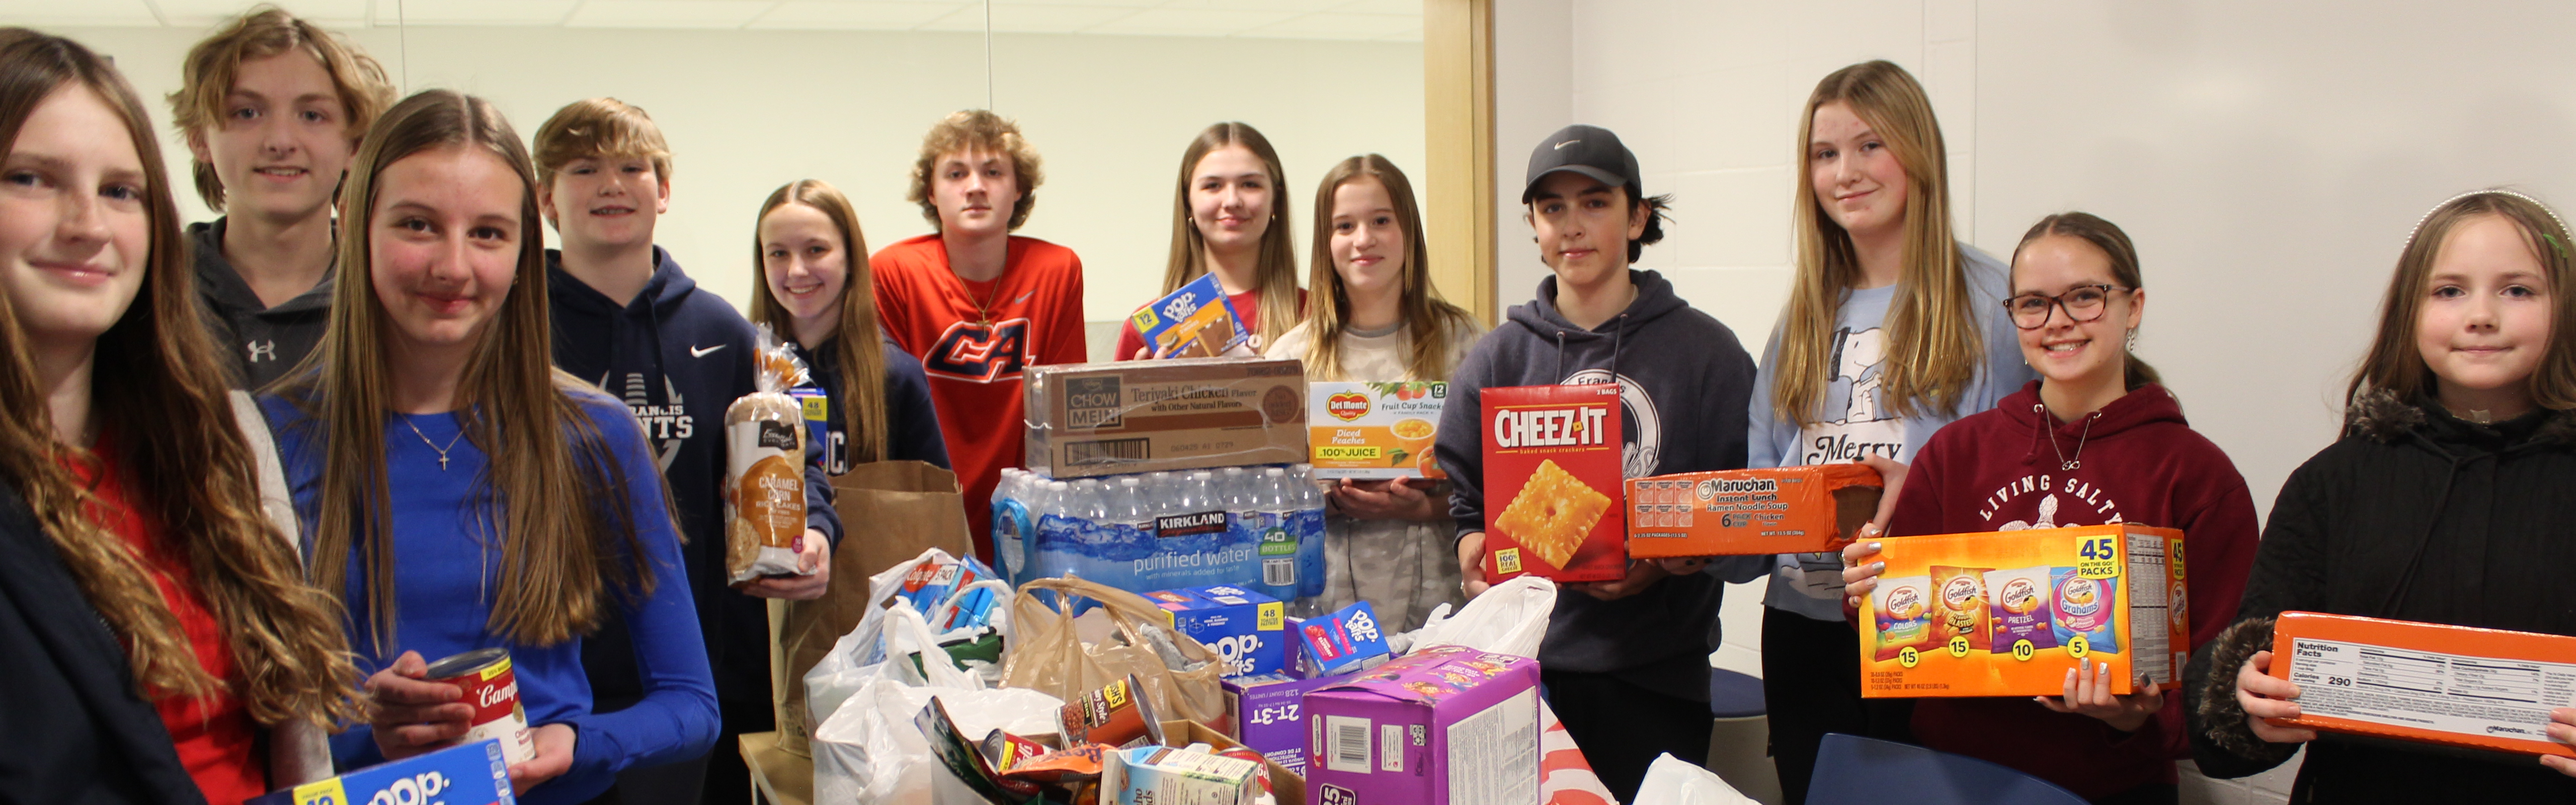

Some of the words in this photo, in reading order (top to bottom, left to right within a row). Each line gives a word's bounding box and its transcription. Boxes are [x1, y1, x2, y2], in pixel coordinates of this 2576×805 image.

[1138, 313, 1152, 325] 12
[923, 318, 1037, 384] CA
[1071, 392, 1117, 407] CHOW
[1131, 386, 1178, 403] Teriyaki
[1181, 384, 1229, 400] Chicken
[627, 404, 684, 416] RANCIS
[1151, 403, 1167, 411] with
[1168, 402, 1188, 411] Other
[1190, 401, 1216, 410] Natural
[1217, 400, 1242, 408] Flavors
[1330, 401, 1343, 409] Del
[1343, 401, 1367, 409] Monte
[1381, 403, 1399, 411] Fruit
[1401, 402, 1417, 411] Cup
[1419, 402, 1442, 410] Snack
[1072, 409, 1115, 424] MEIN
[1336, 429, 1361, 437] Diced
[1345, 448, 1376, 457] JUICE
[1806, 434, 1903, 465] Merry
[759, 477, 800, 491] CARAMEL
[1716, 494, 1749, 503] Instant
[1751, 493, 1777, 502] Lunch
[1979, 474, 2051, 521] LIVING
[2064, 478, 2123, 526] SALTY
[1706, 503, 1735, 512] Ramen
[1736, 502, 1766, 511] Noodle
[1767, 502, 1789, 512] Soup
[1160, 513, 1225, 529] KIRKLAND
[1721, 513, 1732, 528] 6
[1264, 531, 1285, 542] 40
[2080, 538, 2114, 560] 45
[2173, 543, 2183, 562] 45
[1133, 550, 1200, 576] purified
[1207, 548, 1251, 565] water
[1161, 569, 1191, 578] minerals
[2081, 566, 2113, 575] PACKS
[1947, 585, 1977, 600] Goldfish
[2068, 583, 2093, 595] Goldfish
[1890, 592, 1920, 610] Goldfish
[2005, 587, 2035, 604] Goldfish
[2062, 600, 2098, 615] Grahams
[1893, 620, 1918, 630] COLORS
[1948, 618, 1974, 628] BLASTED
[2008, 615, 2034, 624] PRETZEL
[1950, 641, 1966, 653] 15
[2015, 644, 2031, 656] 10
[2074, 642, 2082, 653] 5
[2296, 648, 2322, 657] Facts
[2297, 642, 2338, 652] Nutrition
[1901, 652, 1916, 663] 15
[2328, 676, 2351, 687] 290
[1285, 689, 1299, 697] 128
[1250, 704, 1299, 725] 2T-3T
[2492, 725, 2526, 734] Maruchan
